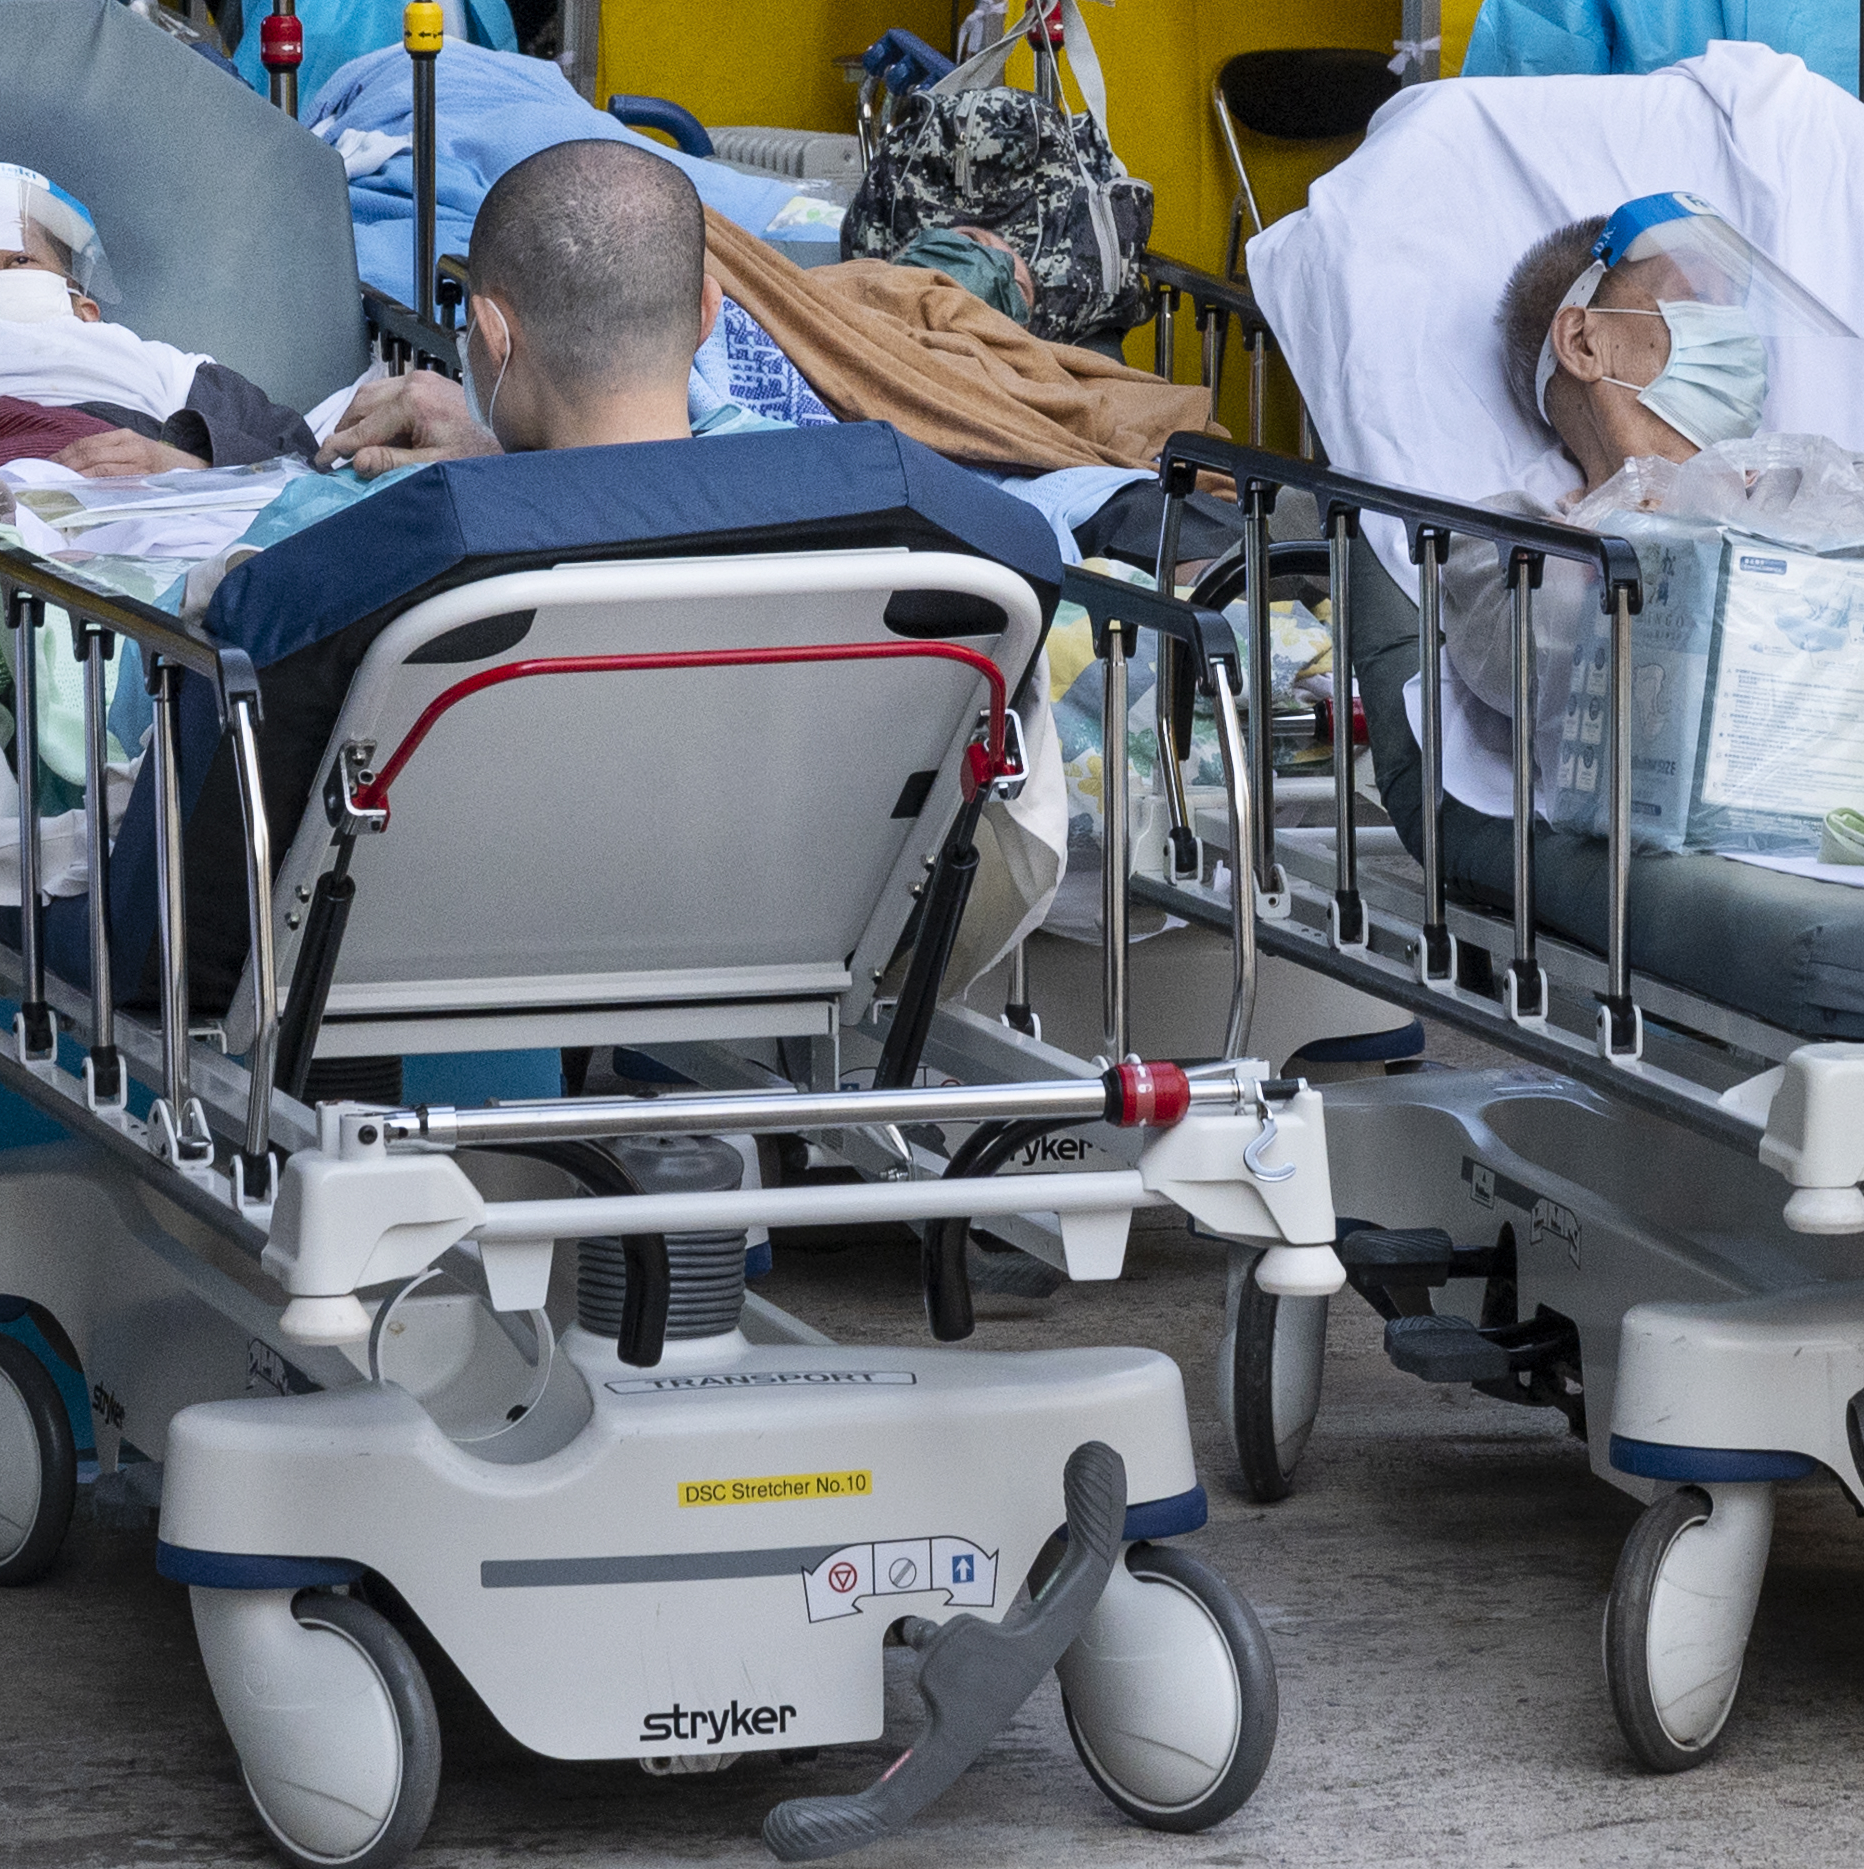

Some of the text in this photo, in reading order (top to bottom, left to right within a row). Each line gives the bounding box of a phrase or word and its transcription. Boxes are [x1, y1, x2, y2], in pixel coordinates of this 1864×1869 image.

[1010, 1136, 1093, 1166] yker
[645, 1372, 877, 1390] TRANSPORT
[686, 1473, 867, 1504] DSC Stretcher No.10
[639, 1699, 797, 1745] stryker
